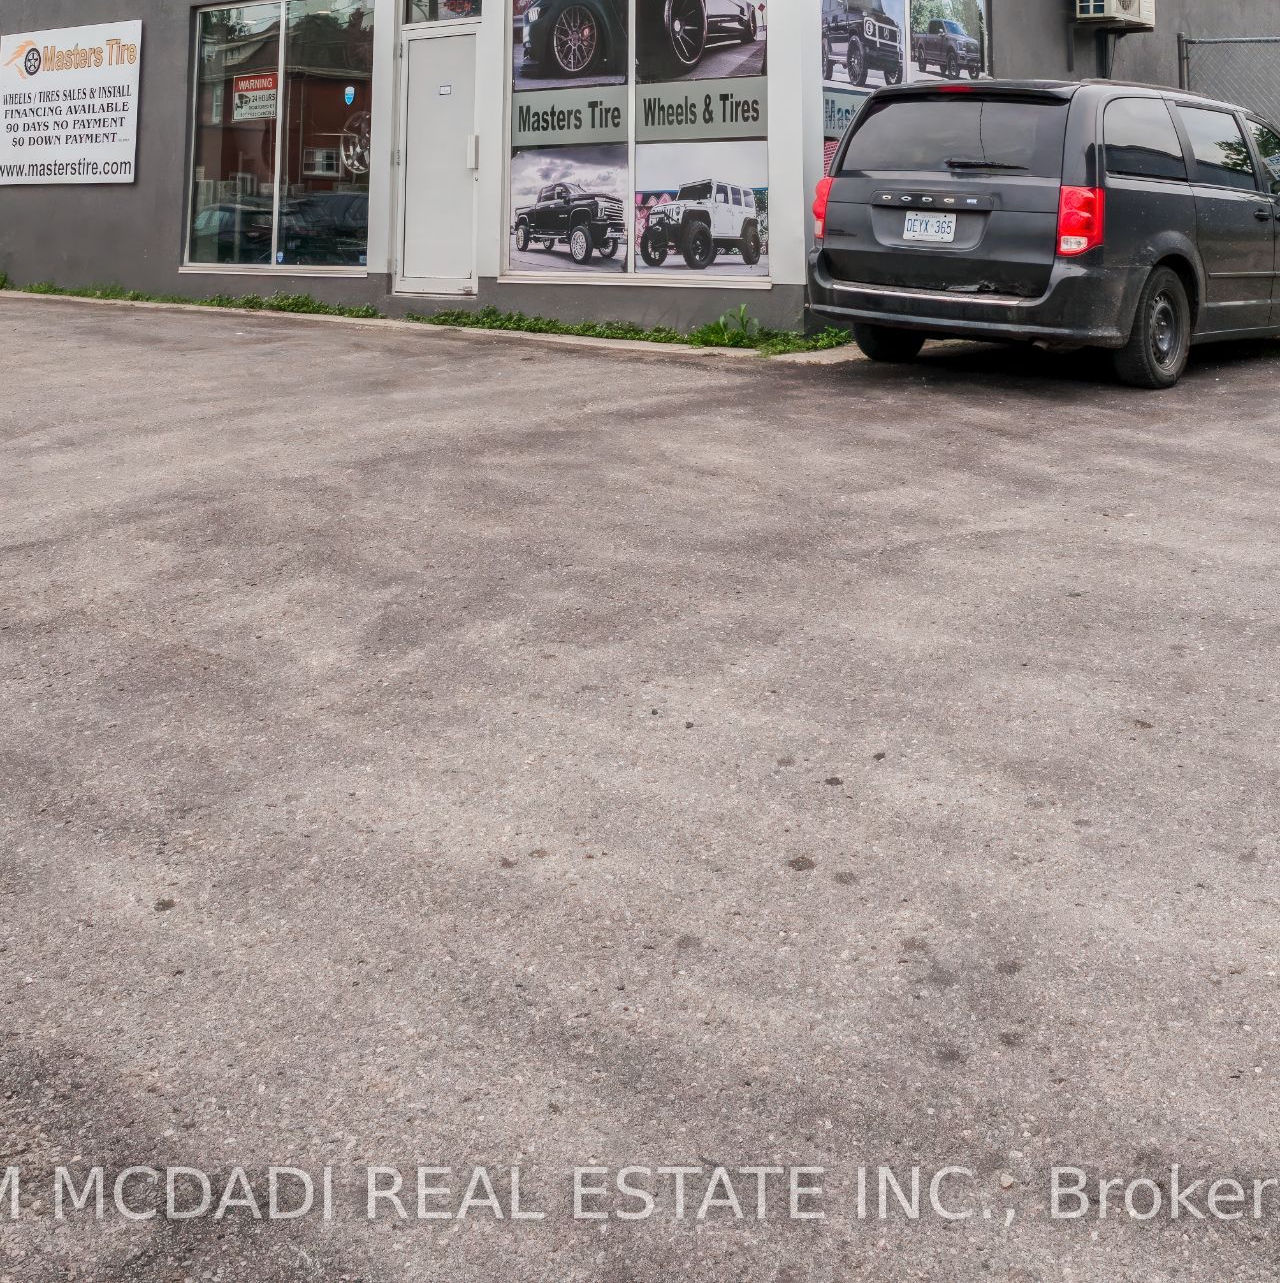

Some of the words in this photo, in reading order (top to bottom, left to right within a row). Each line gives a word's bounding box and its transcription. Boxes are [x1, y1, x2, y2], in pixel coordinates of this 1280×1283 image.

[42, 43, 104, 72] Masters
[105, 38, 138, 66] Tire
[238, 77, 273, 90] WARNING
[2, 92, 32, 106] WHEELS
[38, 89, 60, 103] TIRES
[62, 87, 87, 102] SALES
[89, 87, 97, 99] &
[98, 84, 132, 99] INSTALL
[4, 105, 63, 119] FINANCING
[65, 101, 130, 115] AVAILABLE
[518, 104, 583, 133] Masters
[587, 101, 621, 129] Tire
[642, 95, 698, 127] Wheels
[702, 93, 714, 124] &
[719, 93, 760, 123] Tires
[6, 123, 19, 133] 90
[22, 121, 50, 132] DAYS
[52, 120, 69, 131] NO
[72, 117, 125, 130] PAYMENT
[11, 136, 25, 147] $0
[28, 134, 61, 146] DOWN
[65, 132, 118, 145] PAYMENT
[906, 218, 930, 233] DEYX
[934, 220, 953, 235] 365
